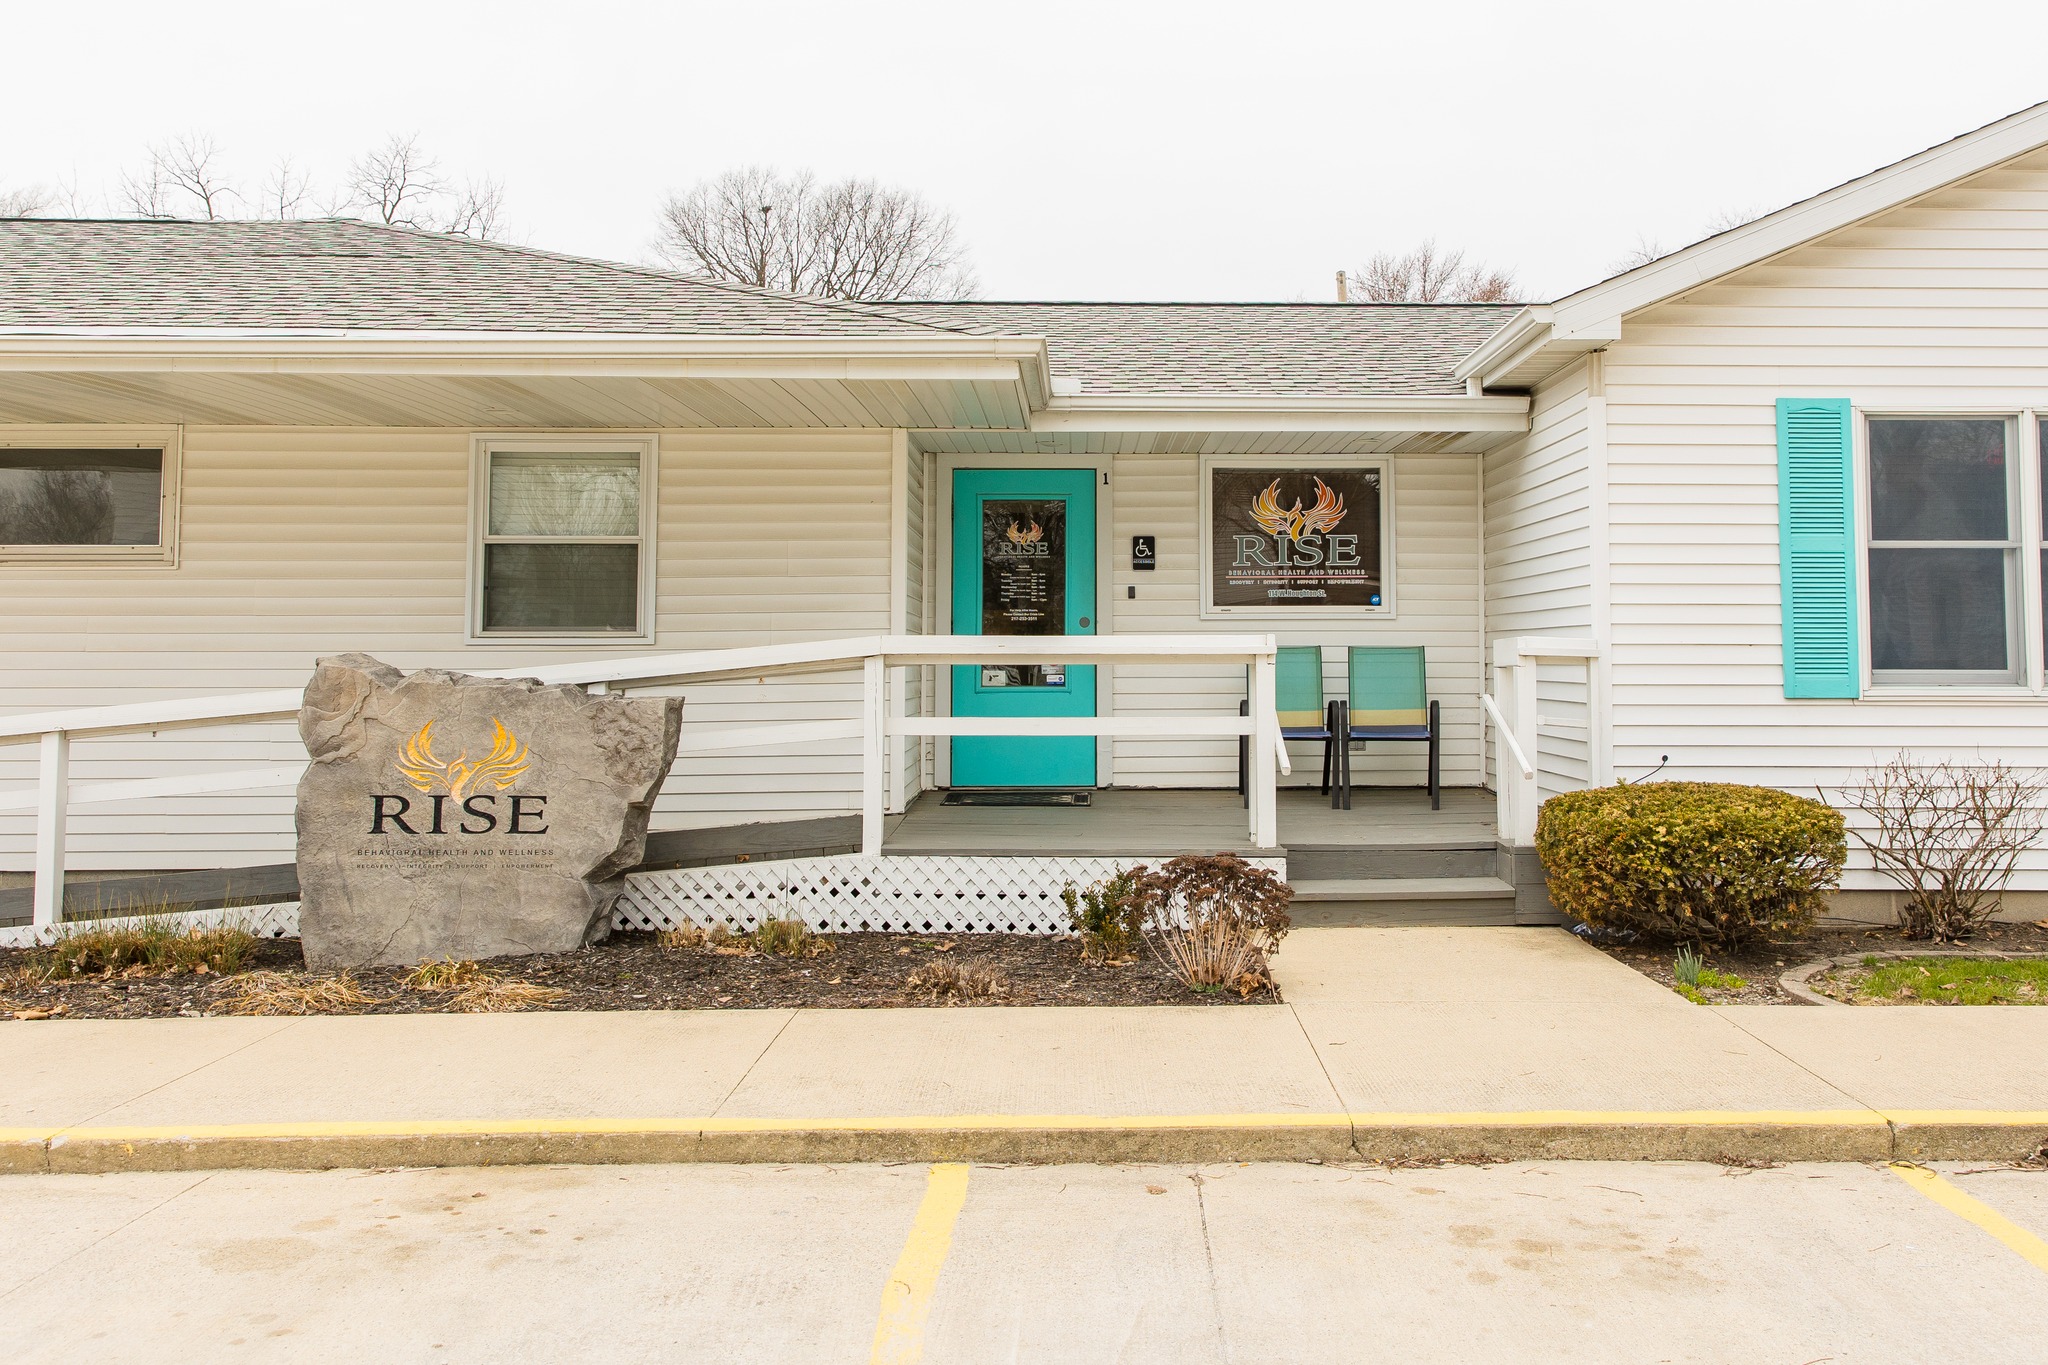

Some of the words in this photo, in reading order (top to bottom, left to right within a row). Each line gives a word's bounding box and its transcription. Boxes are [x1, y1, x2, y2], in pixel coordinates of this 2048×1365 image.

[1103, 472, 1109, 485] 1
[999, 541, 1049, 555] RISE
[1232, 534, 1361, 566] RISE
[1287, 588, 1317, 598] Houghton
[367, 794, 549, 834] RISE
